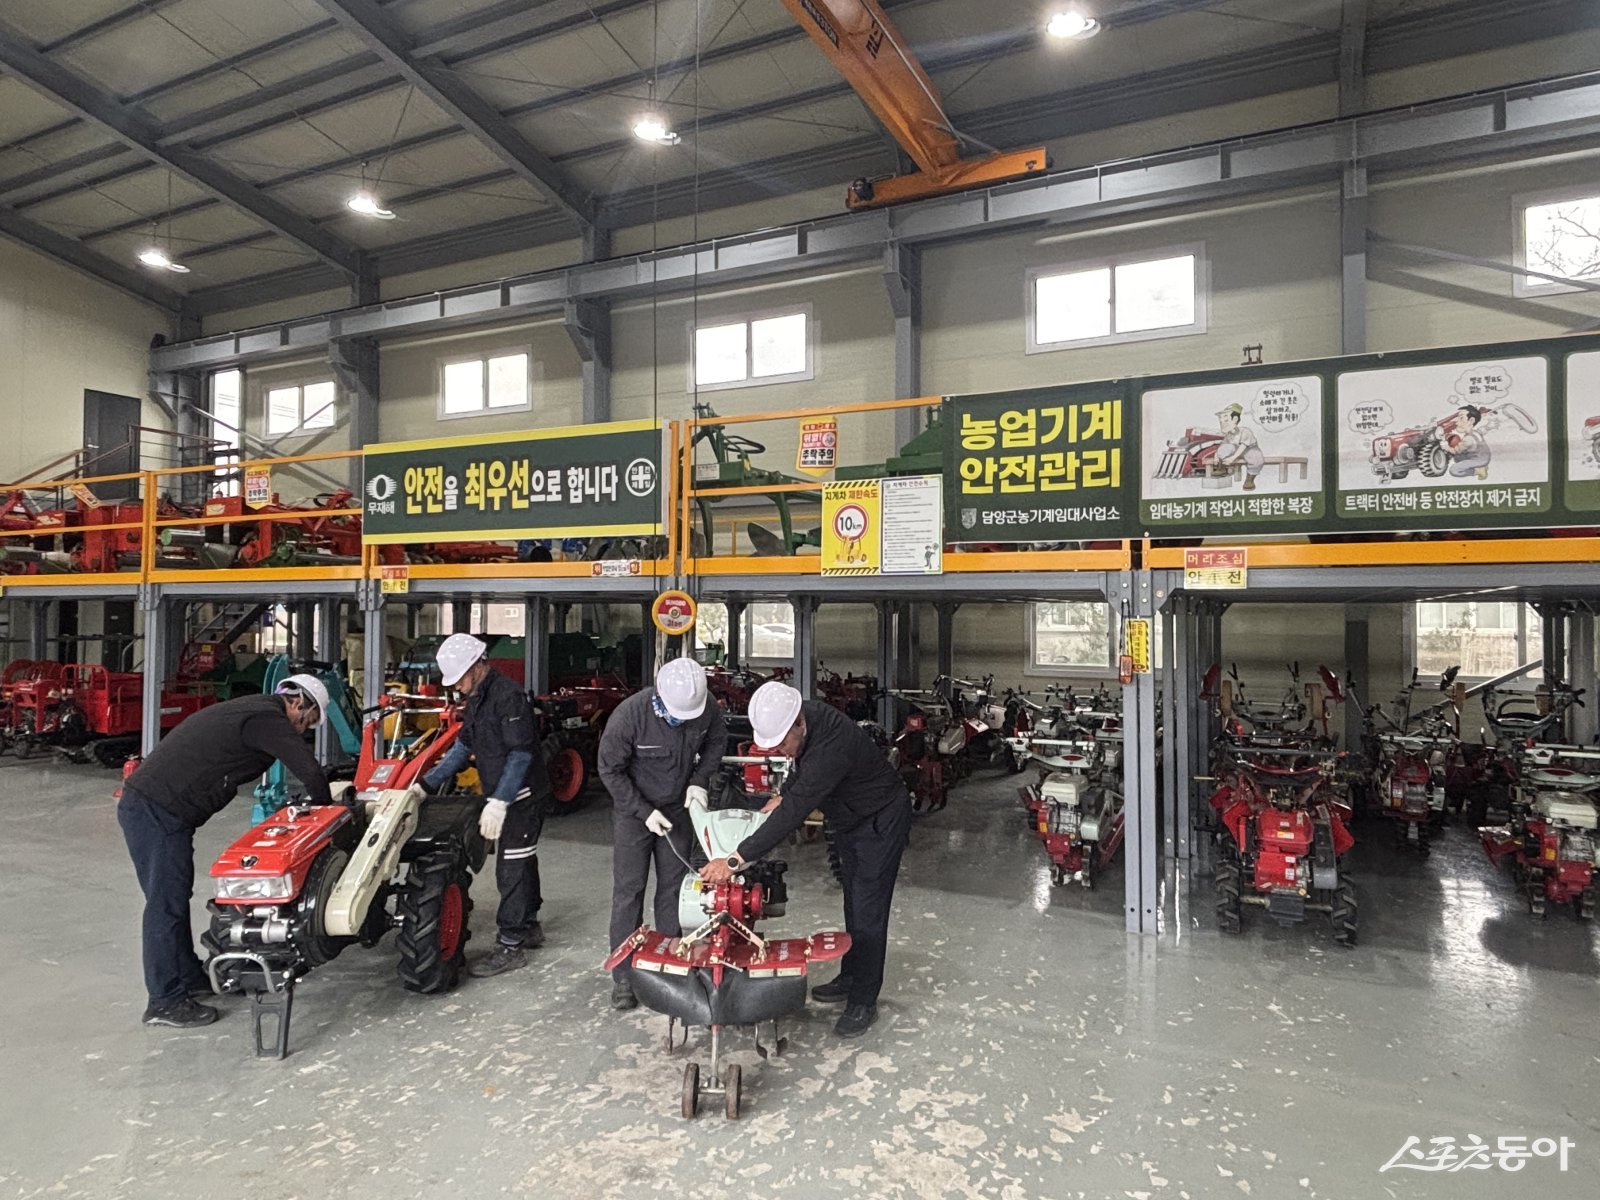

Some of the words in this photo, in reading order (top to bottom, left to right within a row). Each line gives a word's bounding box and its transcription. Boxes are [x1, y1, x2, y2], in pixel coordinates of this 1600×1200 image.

[960, 400, 1122, 450] 농업기계
[802, 449, 834, 460] 추락주의
[960, 448, 1121, 495] 안전관리
[404, 465, 459, 515] 안전을
[464, 459, 562, 511] 최우선으로
[567, 464, 618, 504] 합니다
[825, 491, 846, 500] 지게차
[848, 489, 878, 499] 제한속도
[367, 500, 396, 515] 무재해
[1149, 501, 1207, 520] 임대농기계
[1209, 499, 1245, 517] 작업시
[1248, 497, 1285, 516] 적합한
[1287, 496, 1313, 514] 복장
[1344, 493, 1380, 512] 트랙터
[1381, 492, 1418, 511] 안전바
[1419, 491, 1433, 509] 등
[1434, 489, 1484, 509] 안전장치
[1486, 488, 1512, 508] 제거
[1514, 487, 1541, 507] 금지
[982, 506, 1120, 525] 담양군농기계임대사업소
[1187, 553, 1243, 566] 머리조심
